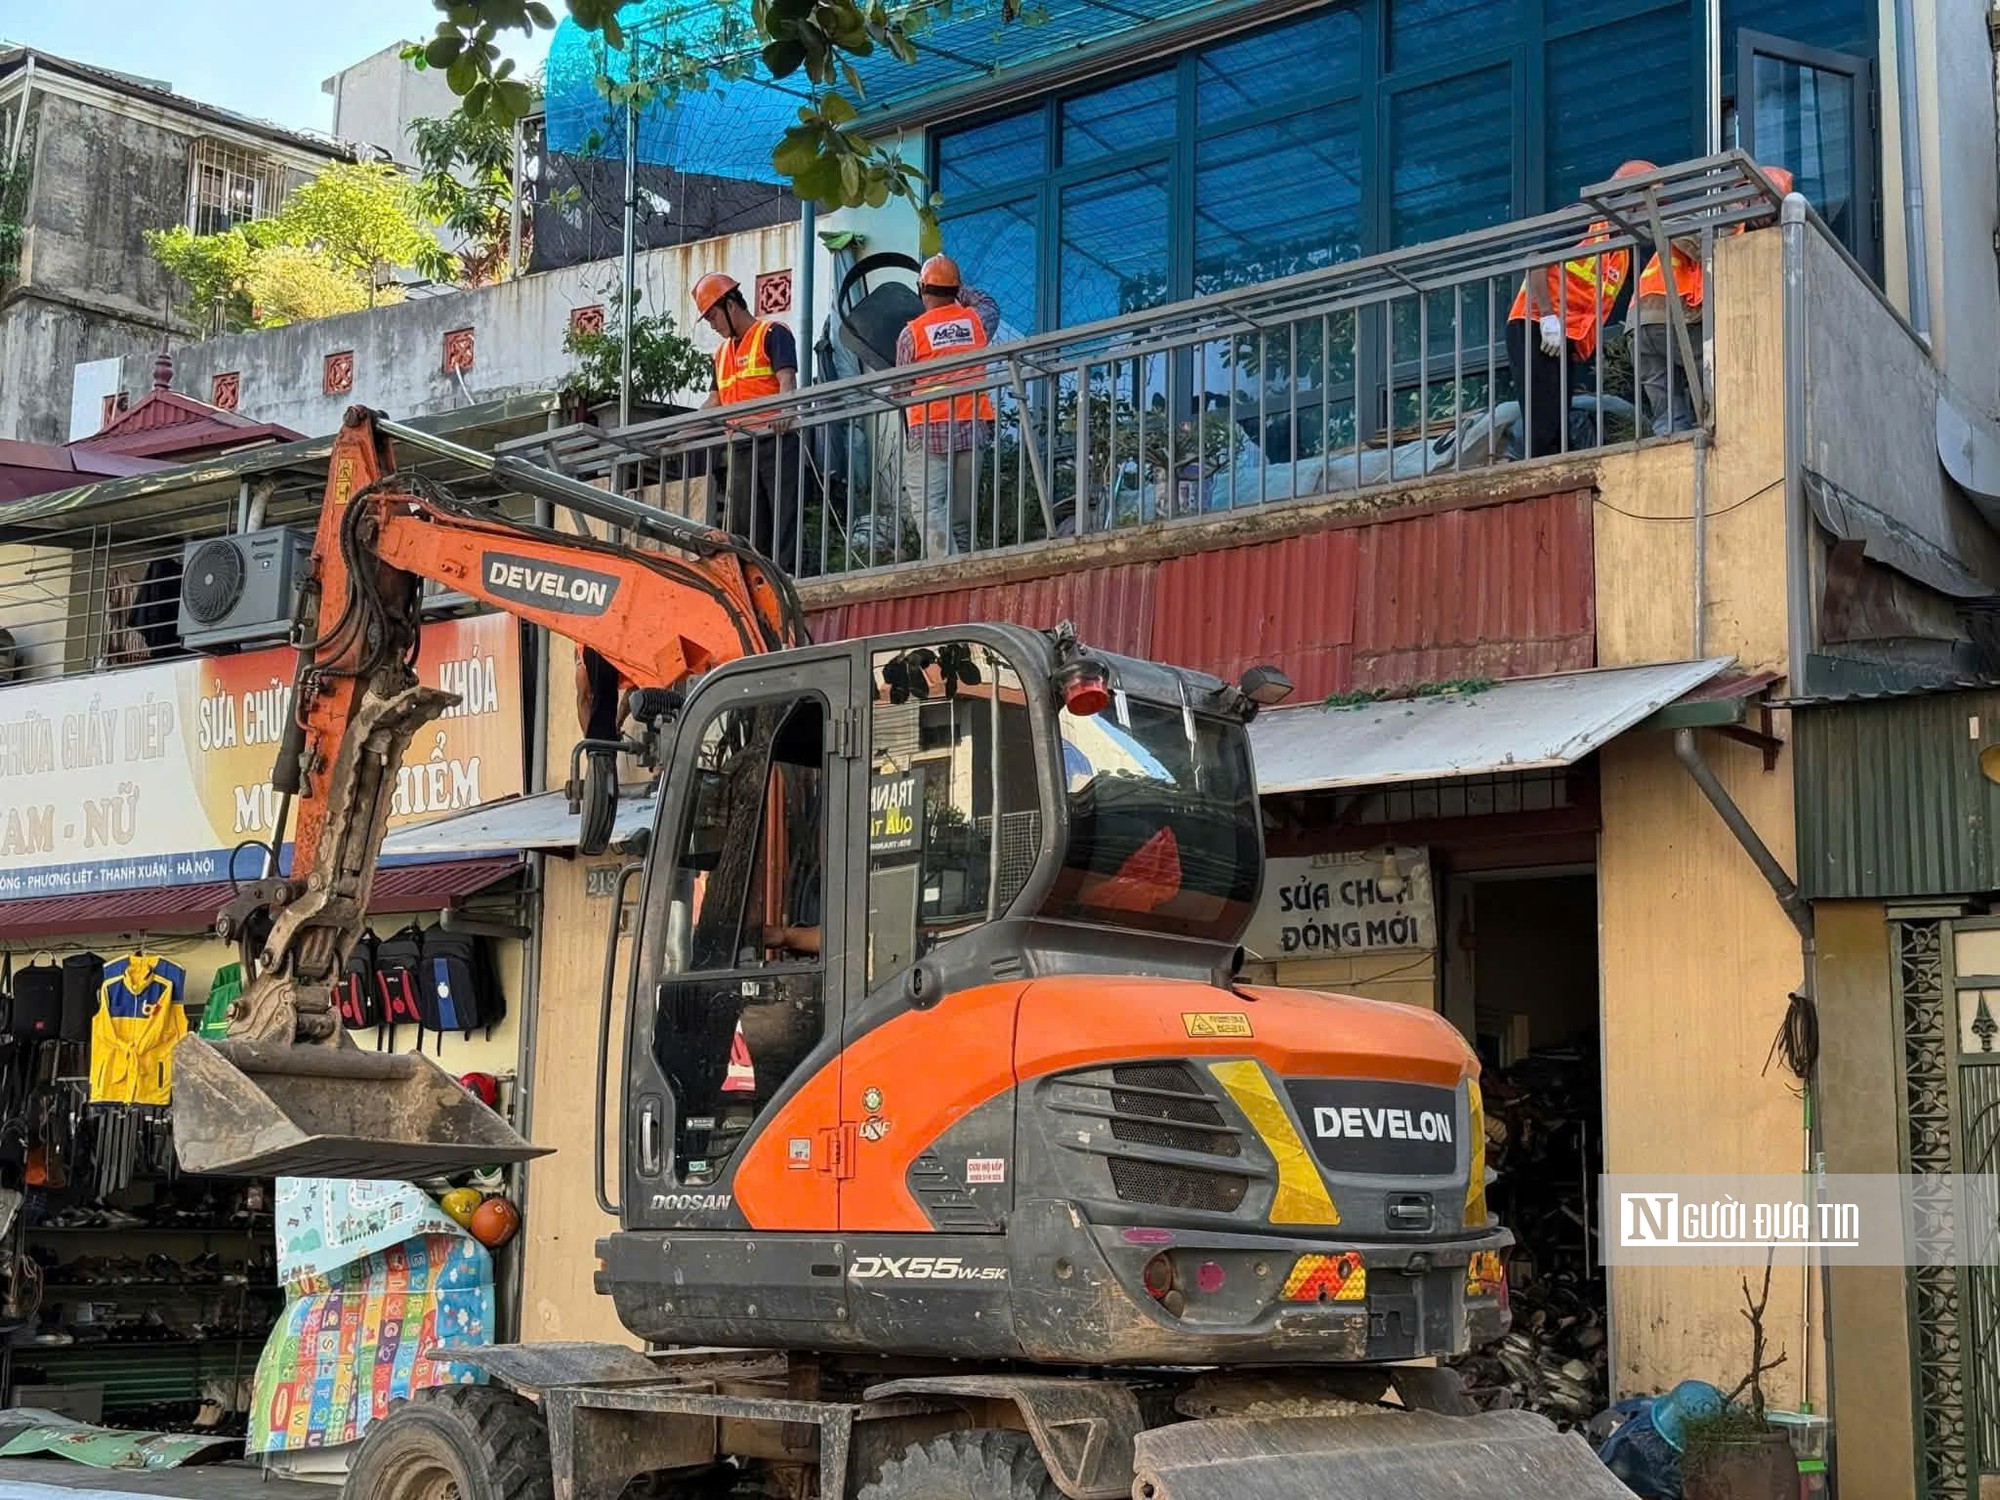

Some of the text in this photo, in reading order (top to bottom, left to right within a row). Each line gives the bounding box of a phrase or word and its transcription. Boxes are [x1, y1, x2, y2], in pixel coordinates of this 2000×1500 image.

[489, 562, 607, 606] DEVELON
[200, 678, 237, 751] SỬA
[439, 644, 499, 720] KHÓA
[124, 693, 174, 762] DÉP
[0, 804, 55, 857] AM
[83, 781, 140, 848] NỮ
[99, 866, 135, 882] THANH
[137, 862, 167, 879] XUÂN
[178, 859, 193, 875] HÀ
[195, 857, 214, 876] NỘI
[1279, 875, 1330, 912] SỬA
[1281, 911, 1418, 951] ĐÓNG MỚI
[1313, 1107, 1453, 1143] DEVELON
[650, 1194, 732, 1212] DOOSAN
